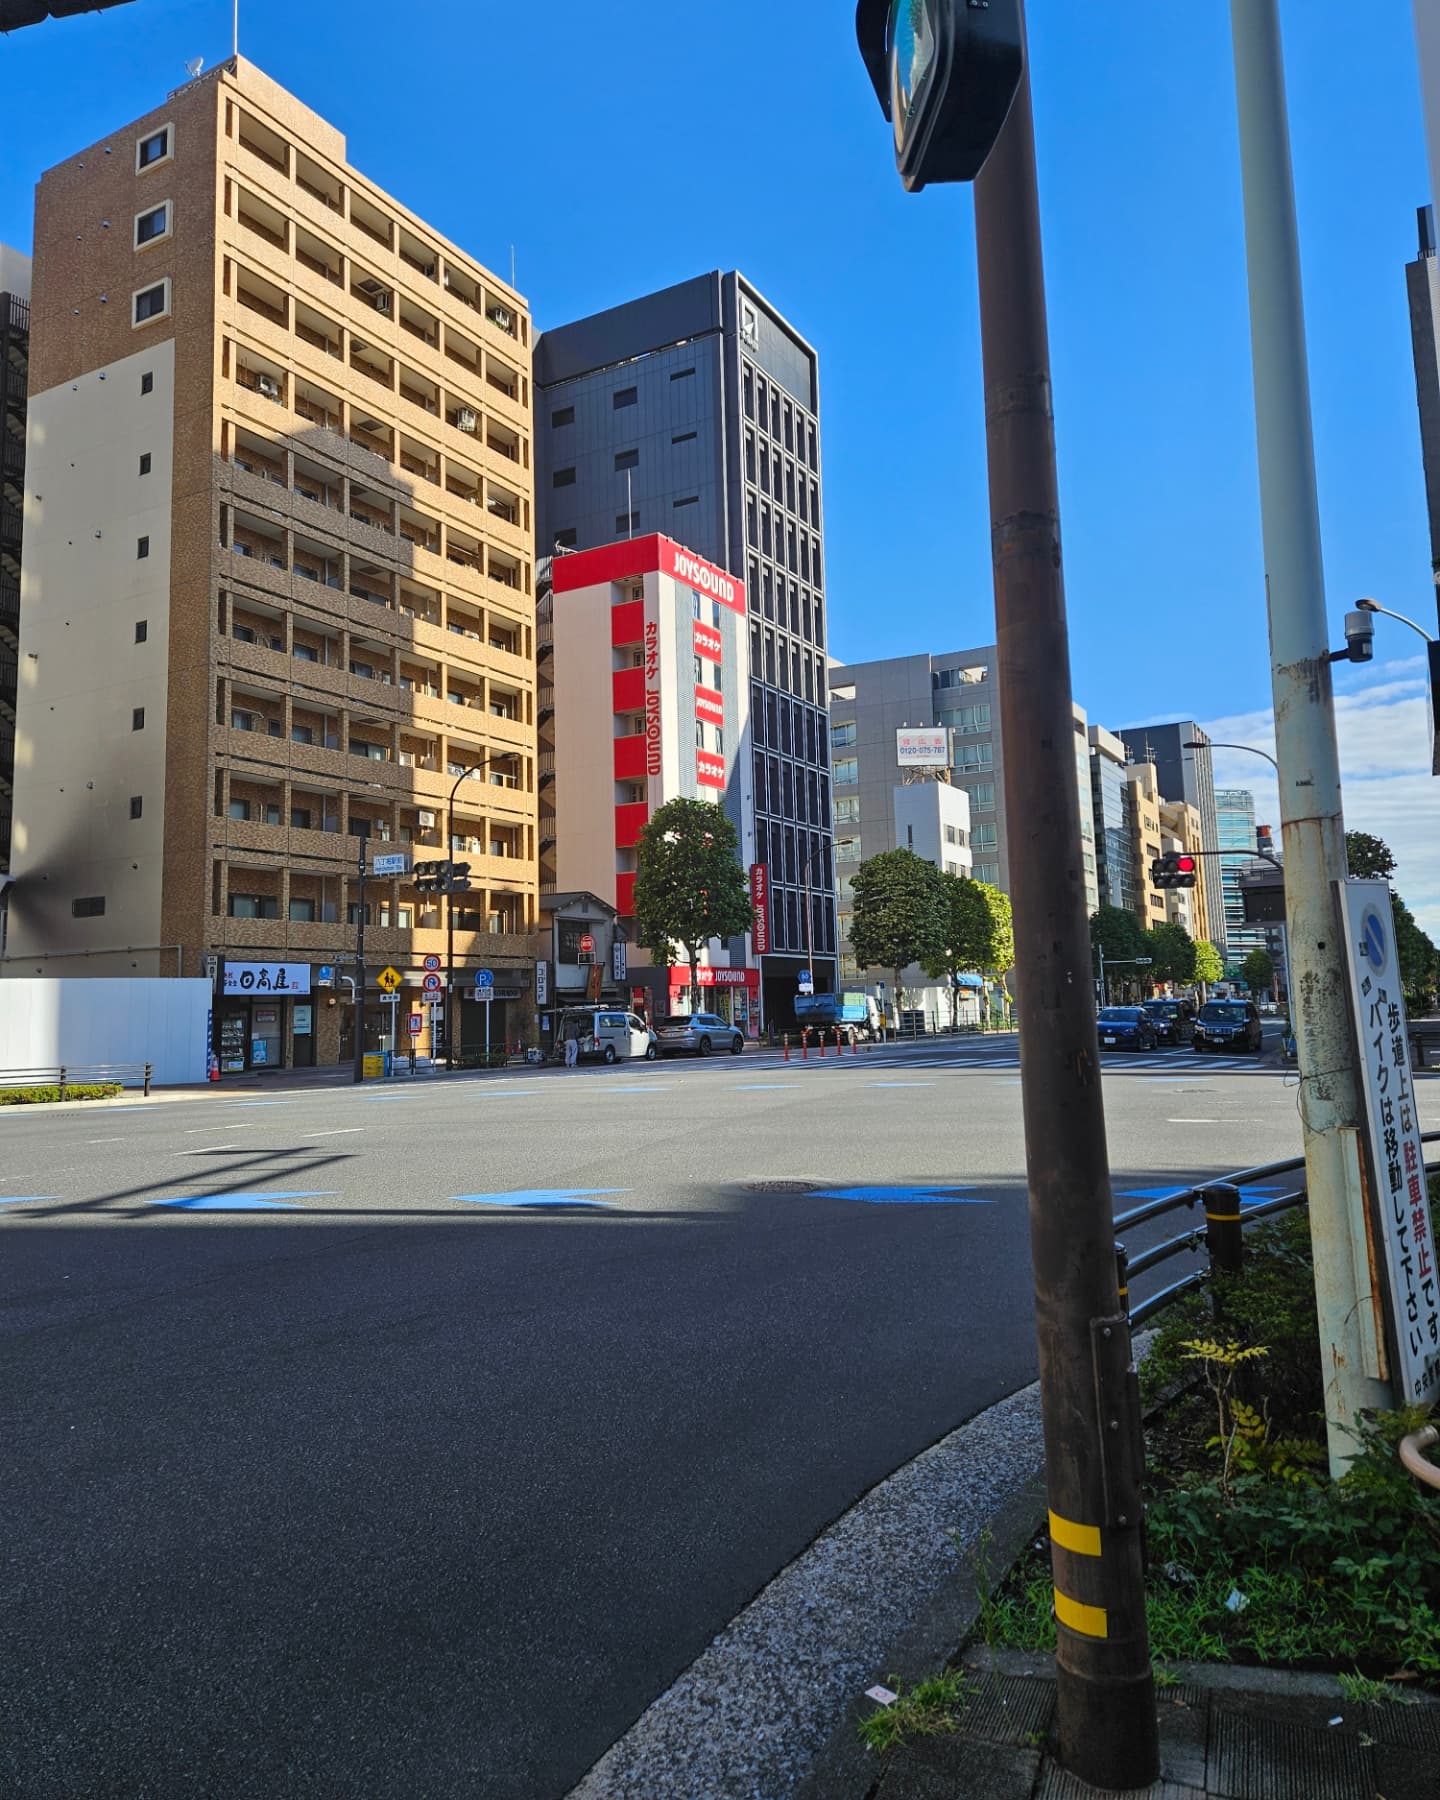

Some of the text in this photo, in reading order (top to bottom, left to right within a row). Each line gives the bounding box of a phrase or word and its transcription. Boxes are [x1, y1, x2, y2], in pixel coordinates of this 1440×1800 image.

[673, 551, 735, 603] JOYSOUND
[695, 631, 721, 653] カラオケ
[645, 621, 661, 776] カラオケ JOYSOUND
[696, 697, 723, 716] JOYSOUND
[698, 760, 724, 780] カラオケ
[756, 867, 766, 951] カラオケ JOYSOUND
[426, 959, 437, 968] 50
[240, 967, 290, 990] 日高屋
[538, 967, 546, 999] コロラド
[715, 970, 745, 983] JOYSOUND
[1387, 1001, 1438, 1345] 歩道上は駐車禁止です
